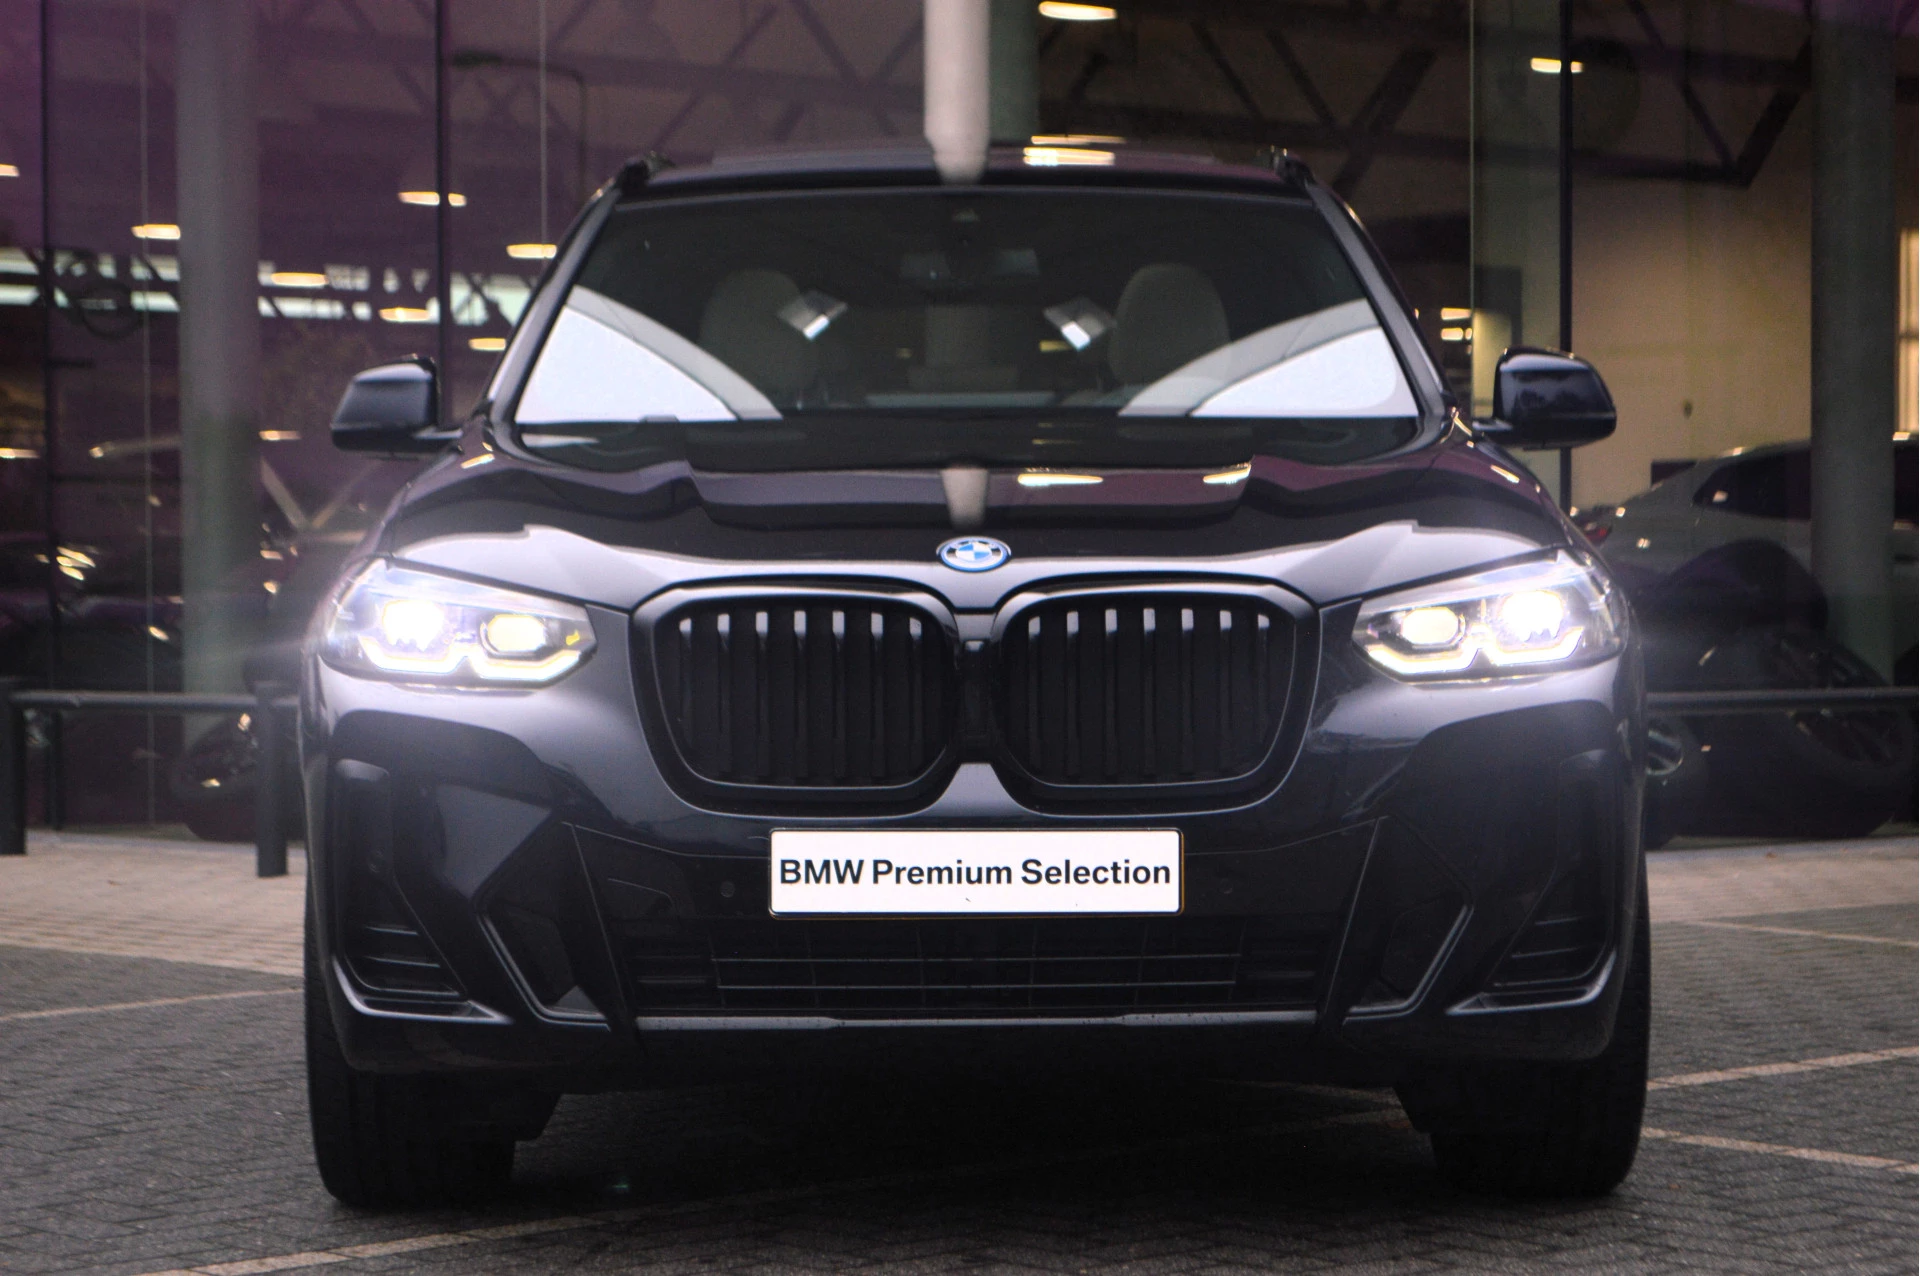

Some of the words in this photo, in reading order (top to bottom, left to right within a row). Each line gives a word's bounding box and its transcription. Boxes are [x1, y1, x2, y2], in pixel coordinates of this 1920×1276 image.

[780, 859, 864, 884] BMW
[873, 859, 1012, 885] Premium
[1021, 858, 1171, 885] Selection
